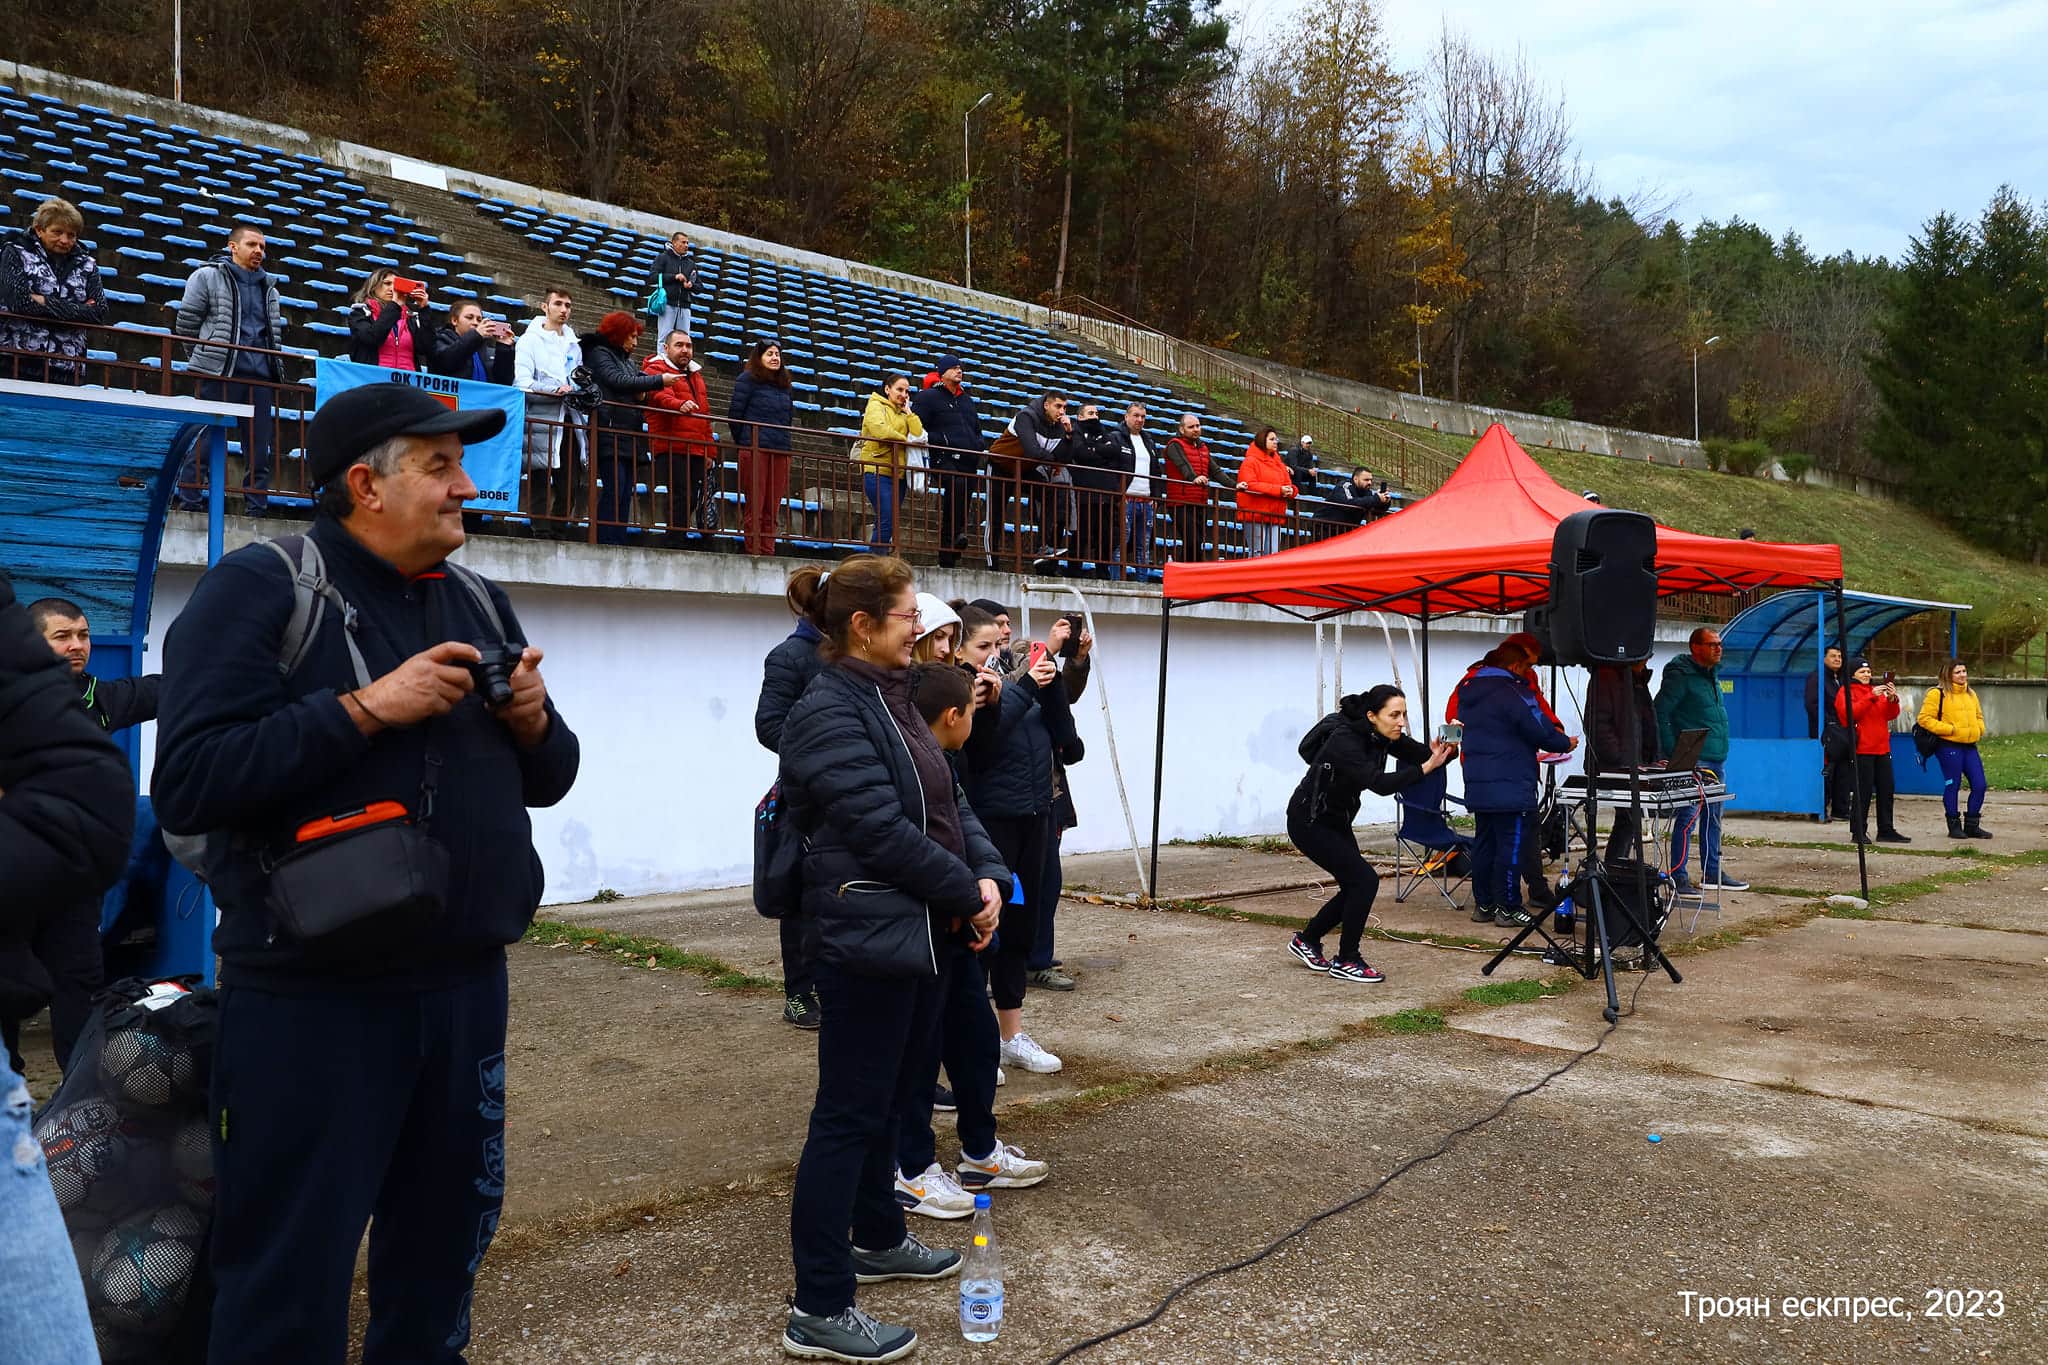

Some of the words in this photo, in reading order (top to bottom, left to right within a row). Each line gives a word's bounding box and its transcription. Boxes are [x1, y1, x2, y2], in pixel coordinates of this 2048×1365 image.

[391, 371, 411, 386] ФК
[415, 374, 459, 394] ТРОЯН
[477, 489, 510, 501] ВОВЕ
